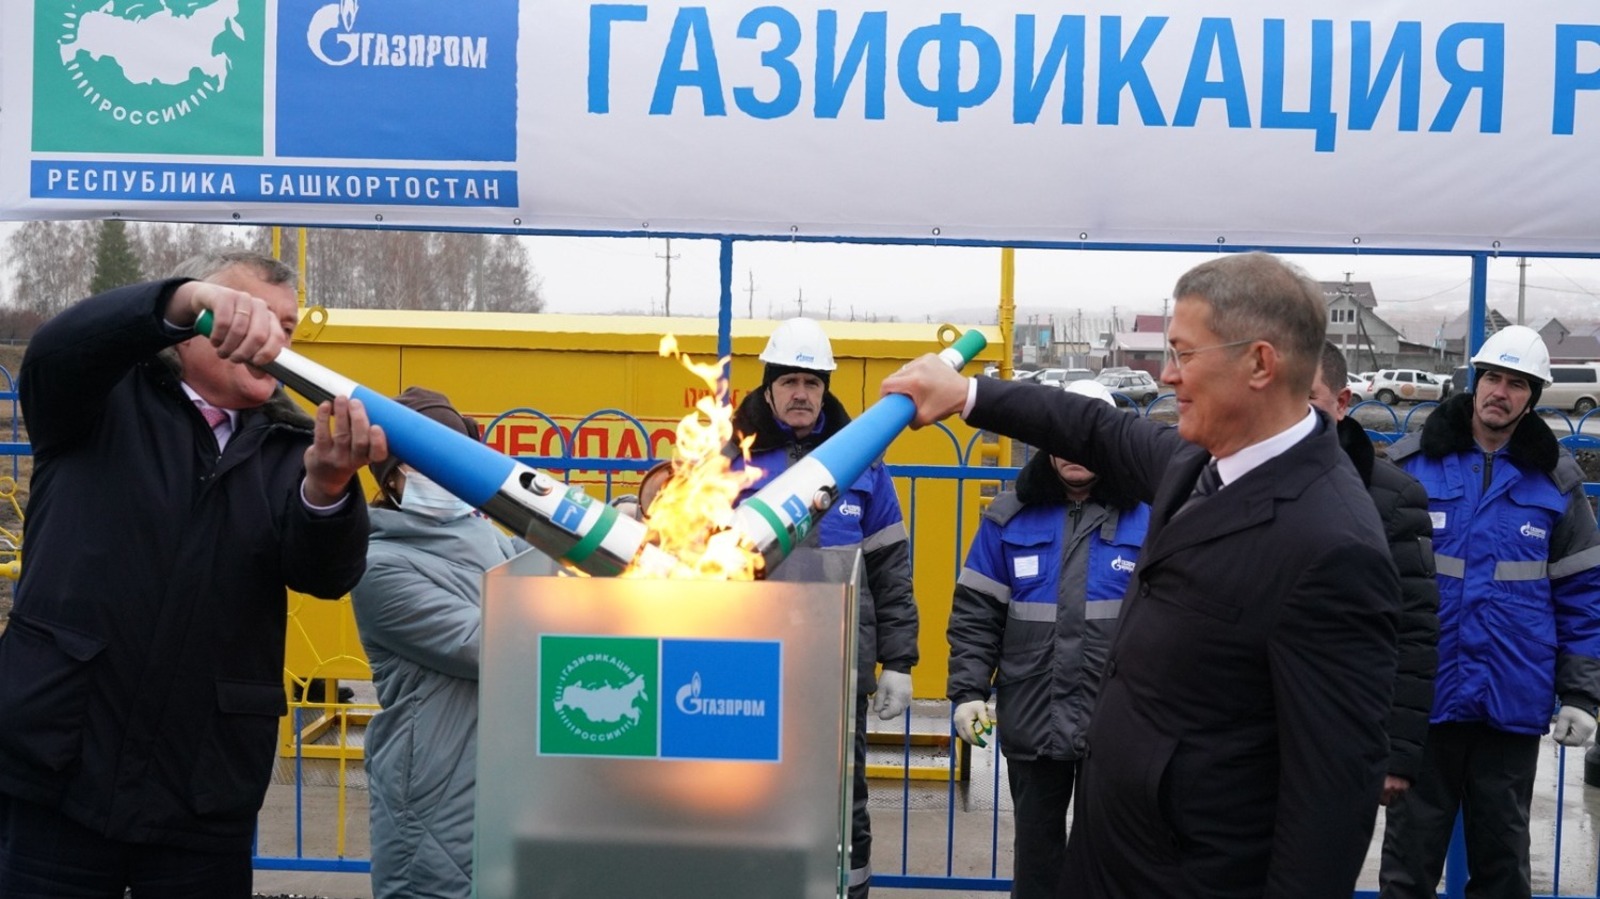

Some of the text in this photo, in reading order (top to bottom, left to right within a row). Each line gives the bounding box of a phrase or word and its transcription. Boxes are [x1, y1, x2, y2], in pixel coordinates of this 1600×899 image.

[361, 33, 488, 69] ГАЗПРОМ
[587, 4, 1505, 153] ГАЗИФИКАЦИЯ
[98, 99, 191, 125] РОССИИ
[48, 169, 499, 200] РЕСПУБЛИКА БАШКОРТОСТАН
[478, 424, 677, 475] НЕОПАС
[562, 653, 636, 680] ГАЗИФИКАЦИЯ
[702, 698, 765, 717] ГАЗПРОМ
[574, 728, 622, 742] РОССИИ
